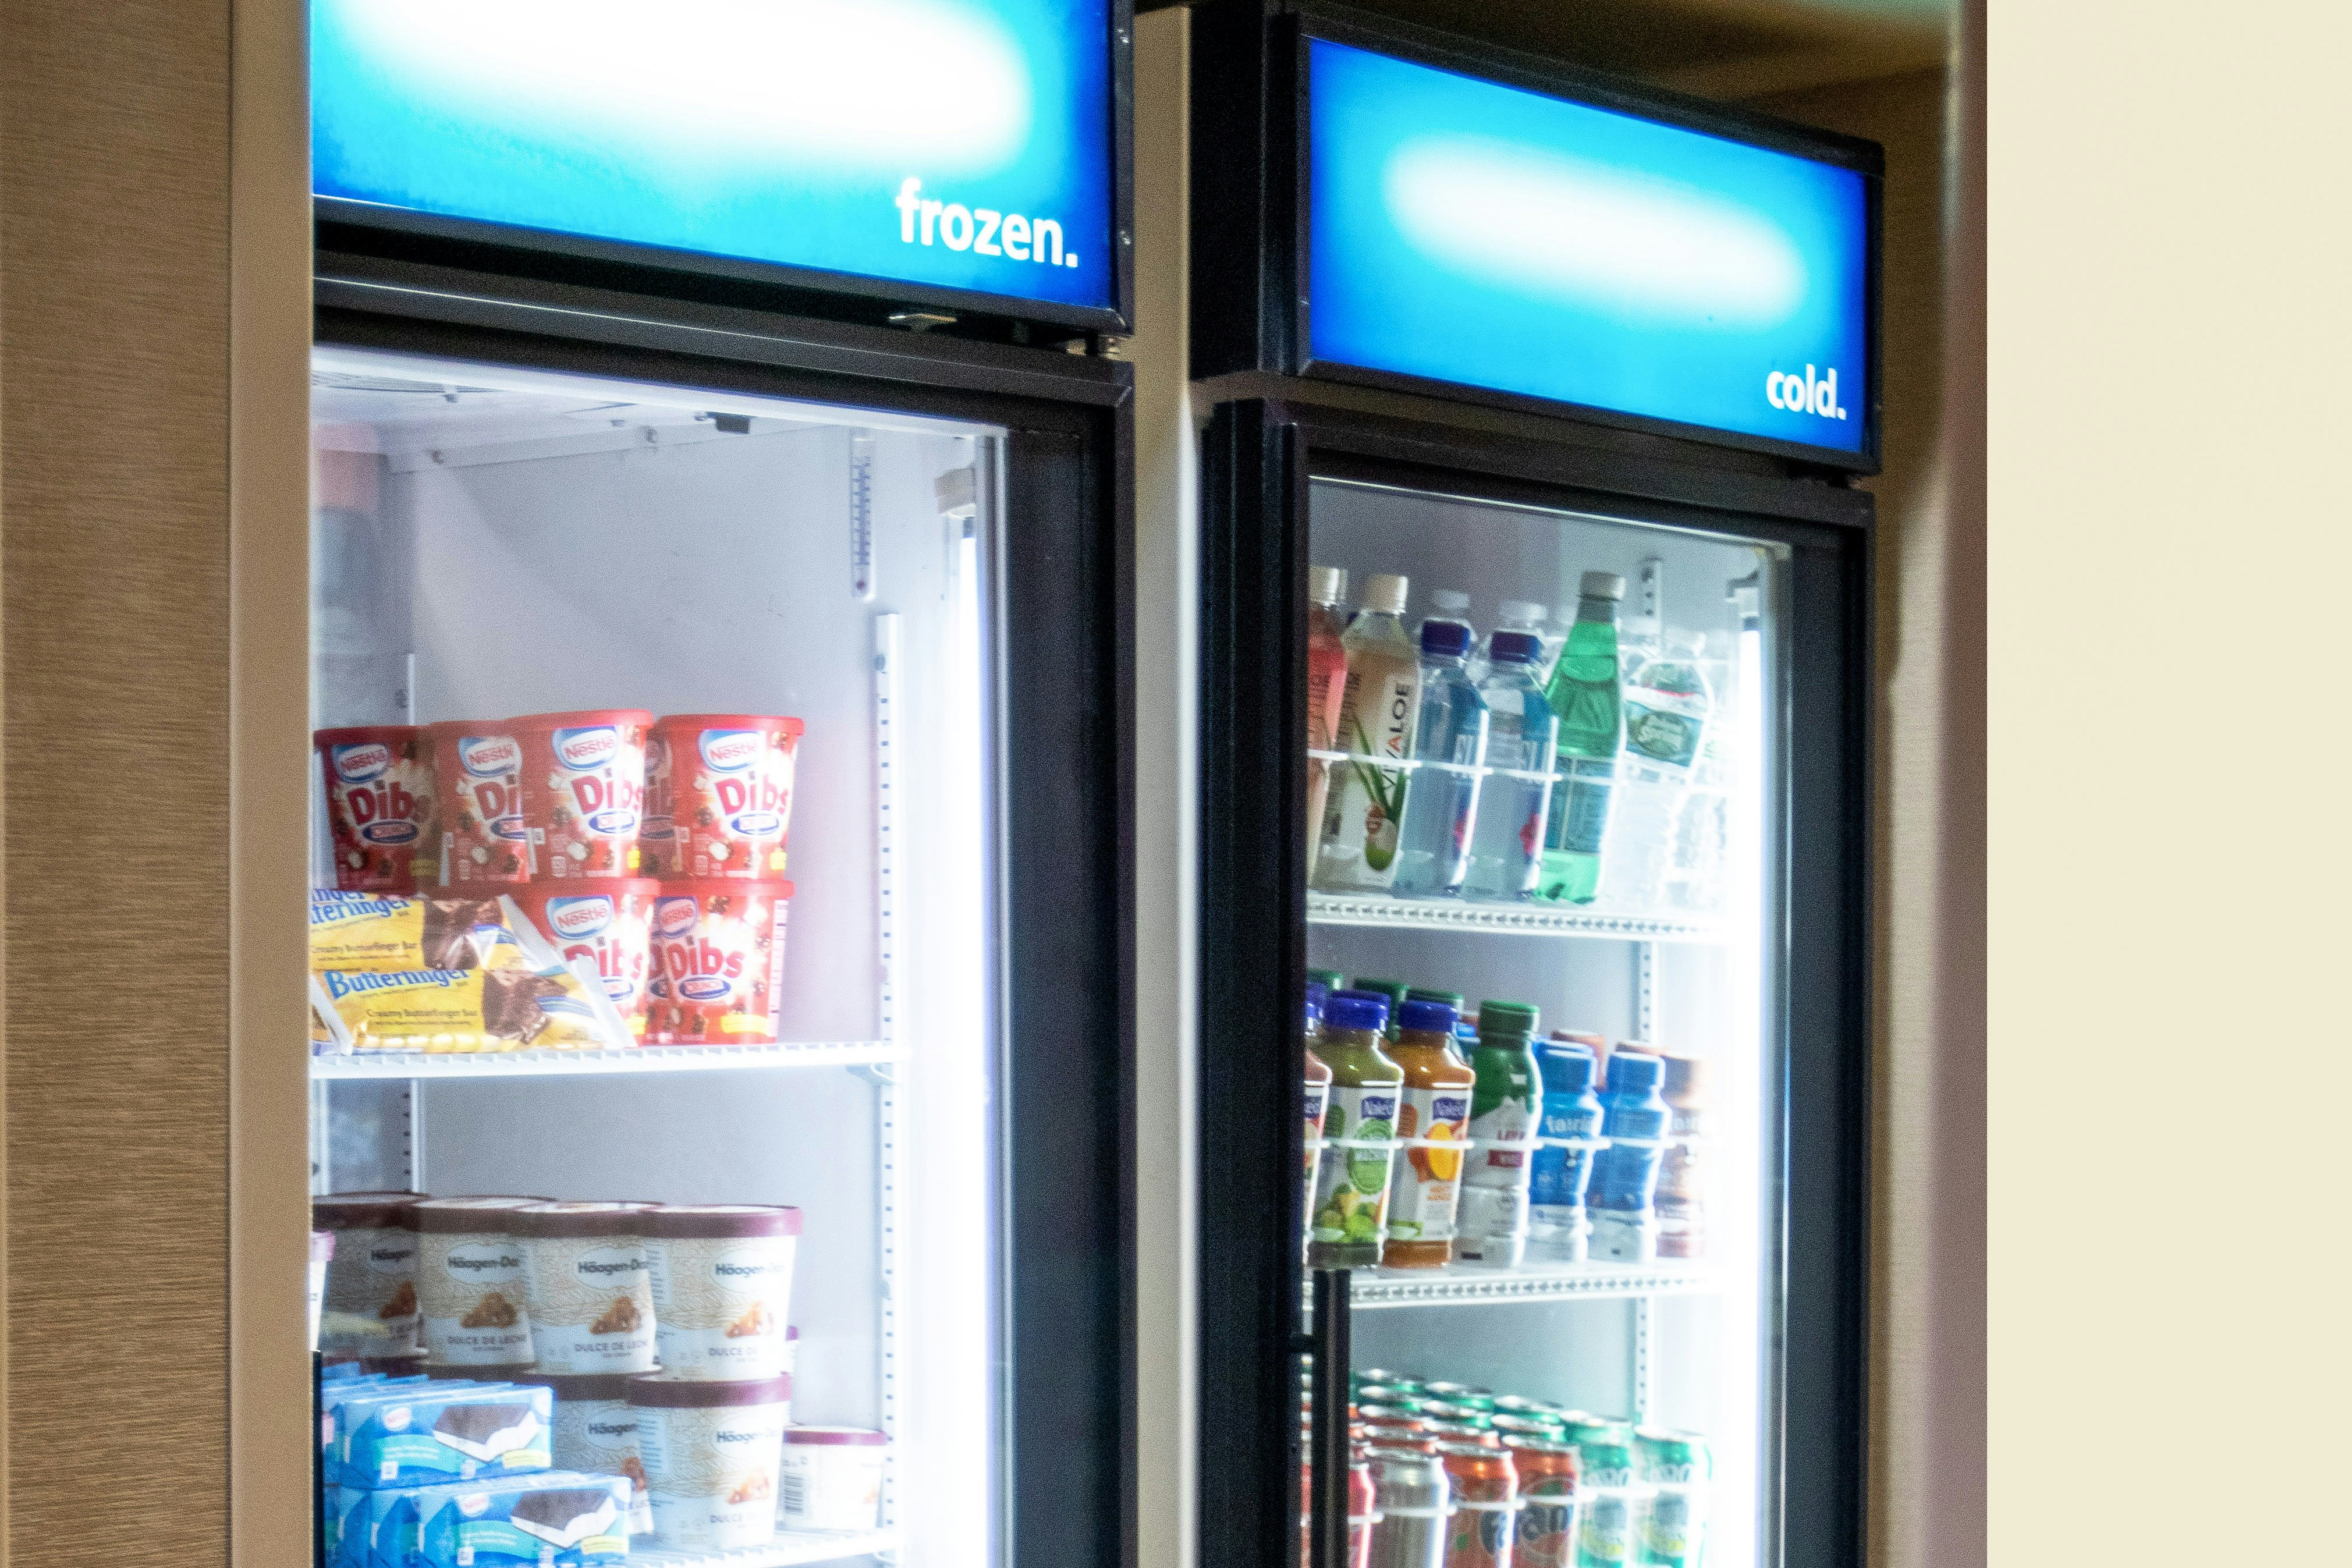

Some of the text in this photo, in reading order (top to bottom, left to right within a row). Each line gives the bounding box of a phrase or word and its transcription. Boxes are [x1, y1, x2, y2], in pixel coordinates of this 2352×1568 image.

[895, 177, 1079, 268] frozen.
[1766, 363, 1847, 420] cold.
[474, 773, 520, 820] Di
[714, 771, 788, 816] Dibs
[666, 935, 746, 981] Dibs
